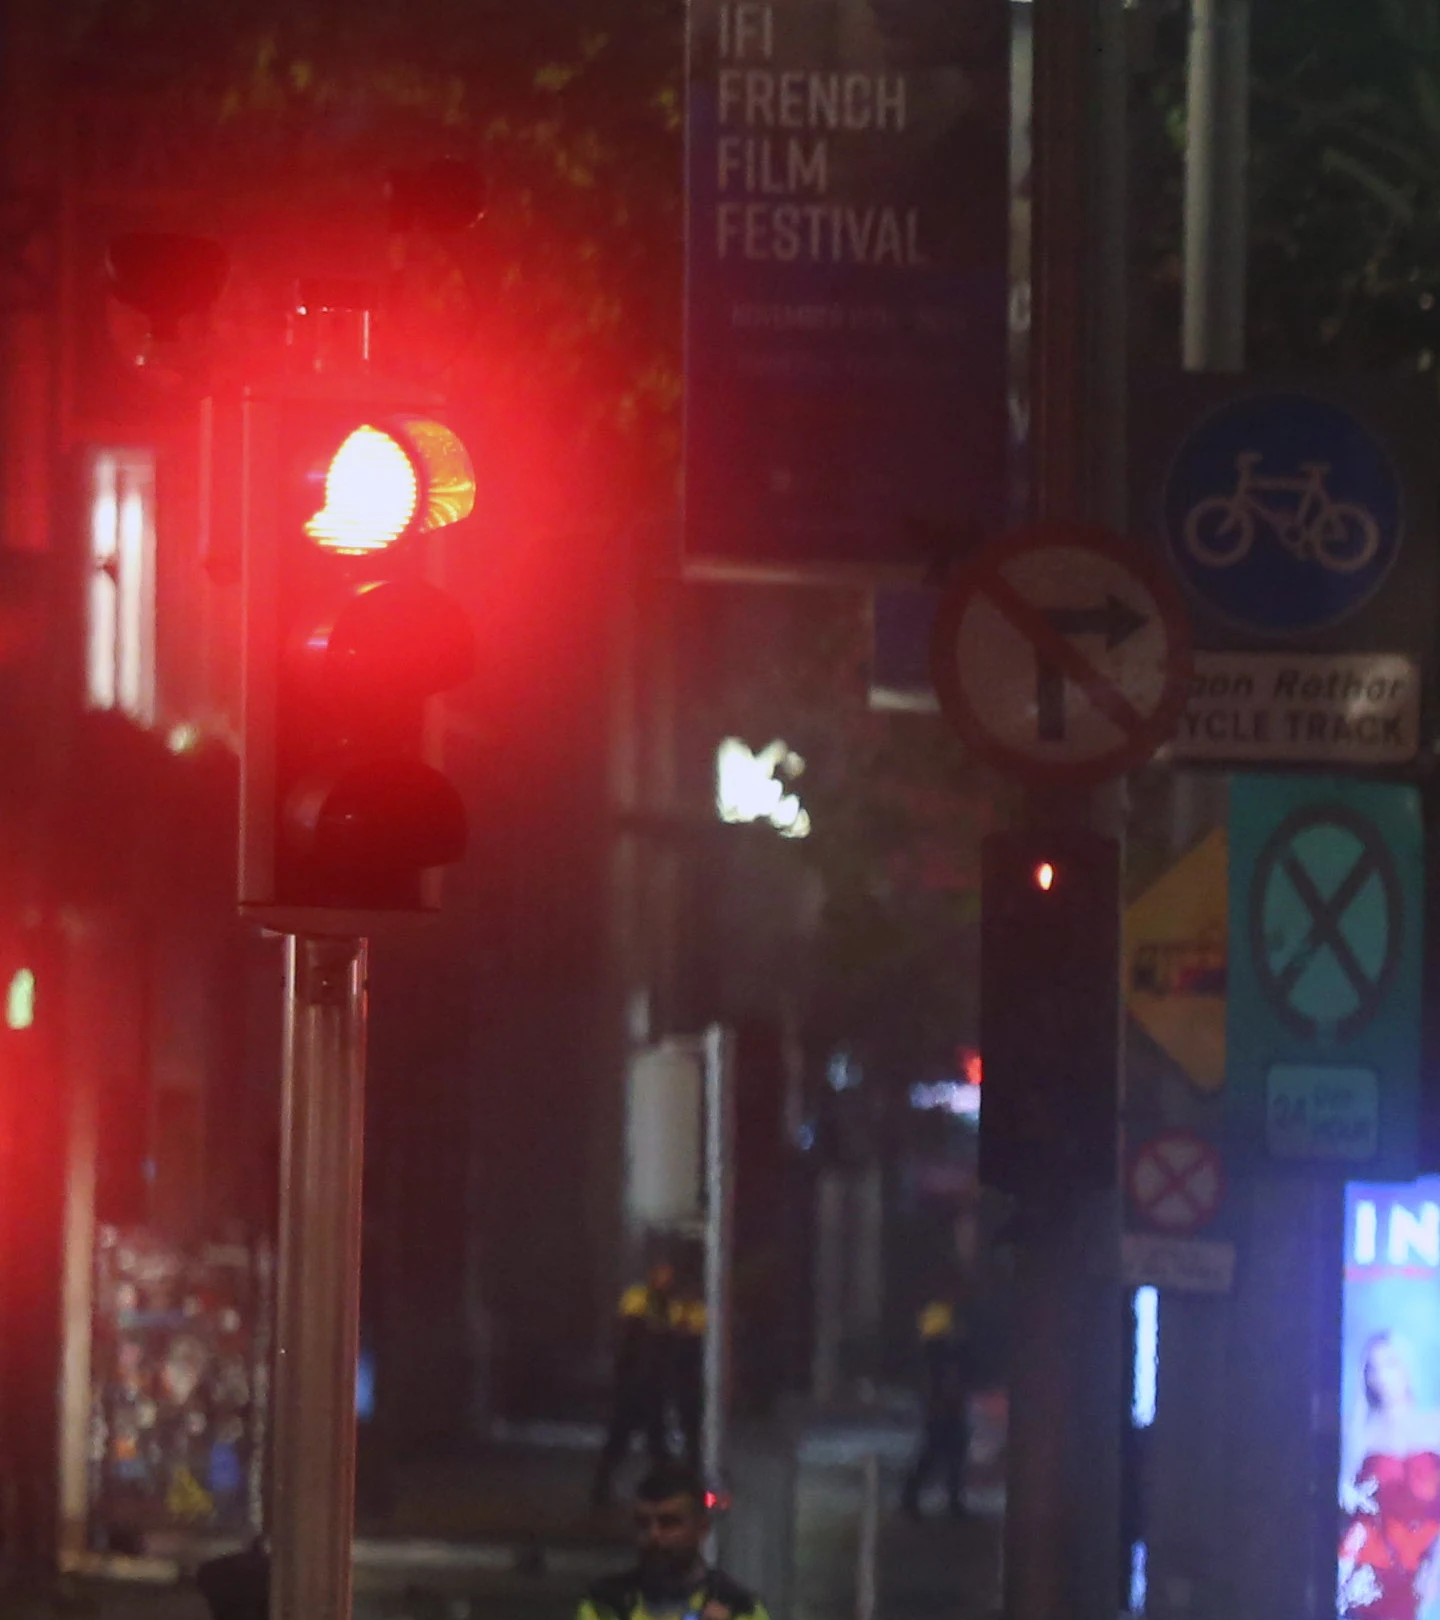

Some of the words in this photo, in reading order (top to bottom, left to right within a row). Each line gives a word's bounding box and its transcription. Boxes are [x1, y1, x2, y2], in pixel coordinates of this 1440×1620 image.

[717, 2, 774, 59] IFI
[717, 69, 907, 131] FRENCH
[716, 136, 828, 195] FILM
[716, 202, 932, 266] FESTIVAL
[1188, 671, 1254, 698] aon
[1182, 709, 1268, 742] YCLE
[1286, 710, 1403, 743] TRACK
[1354, 1200, 1440, 1268] IN
